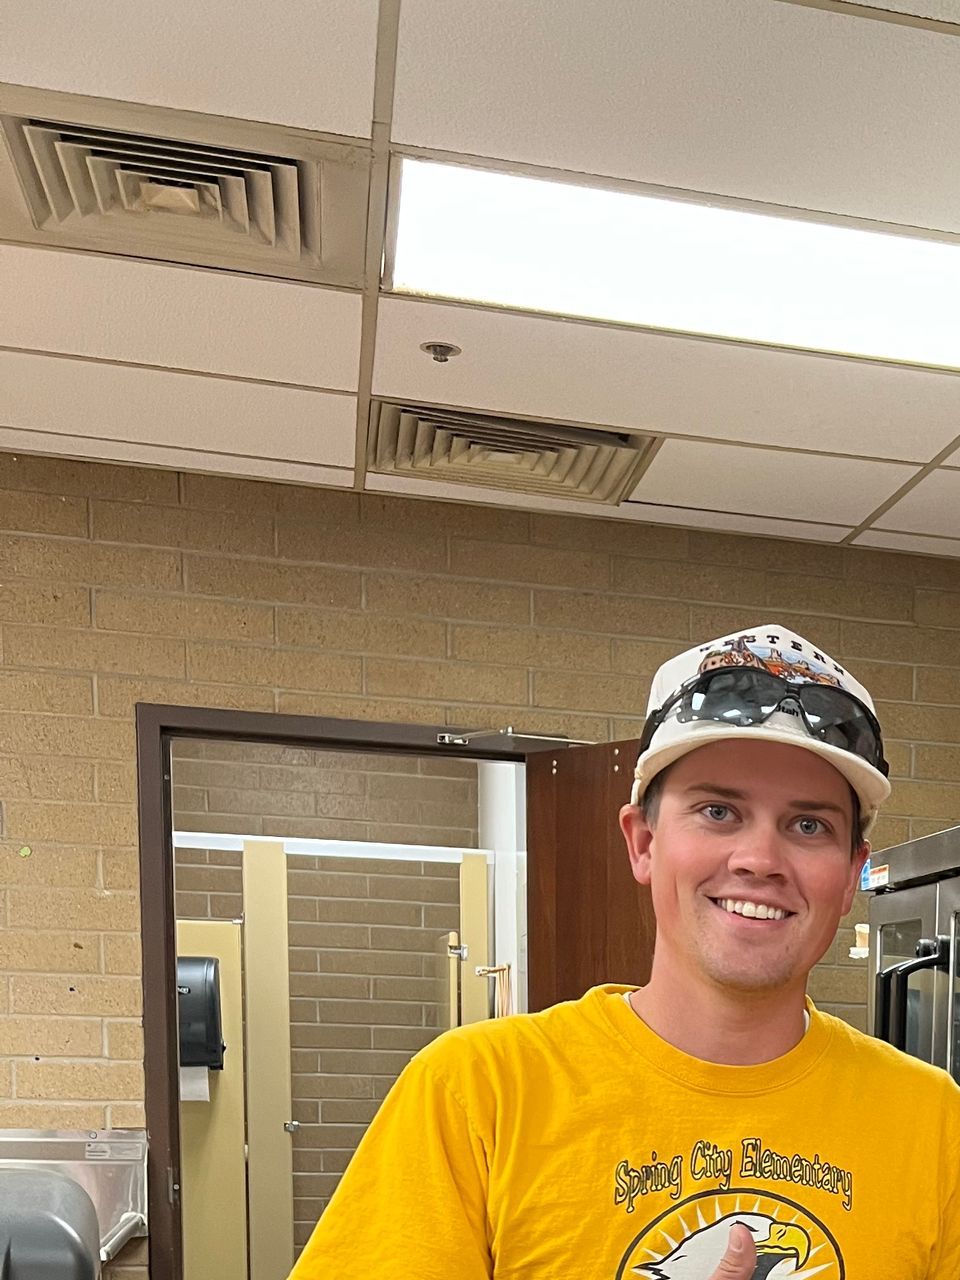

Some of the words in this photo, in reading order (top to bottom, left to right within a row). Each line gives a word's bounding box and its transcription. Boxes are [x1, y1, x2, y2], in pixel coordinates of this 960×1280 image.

[614, 1152, 683, 1212] Spring
[690, 1140, 732, 1190] City
[739, 1137, 853, 1211] Elementary
